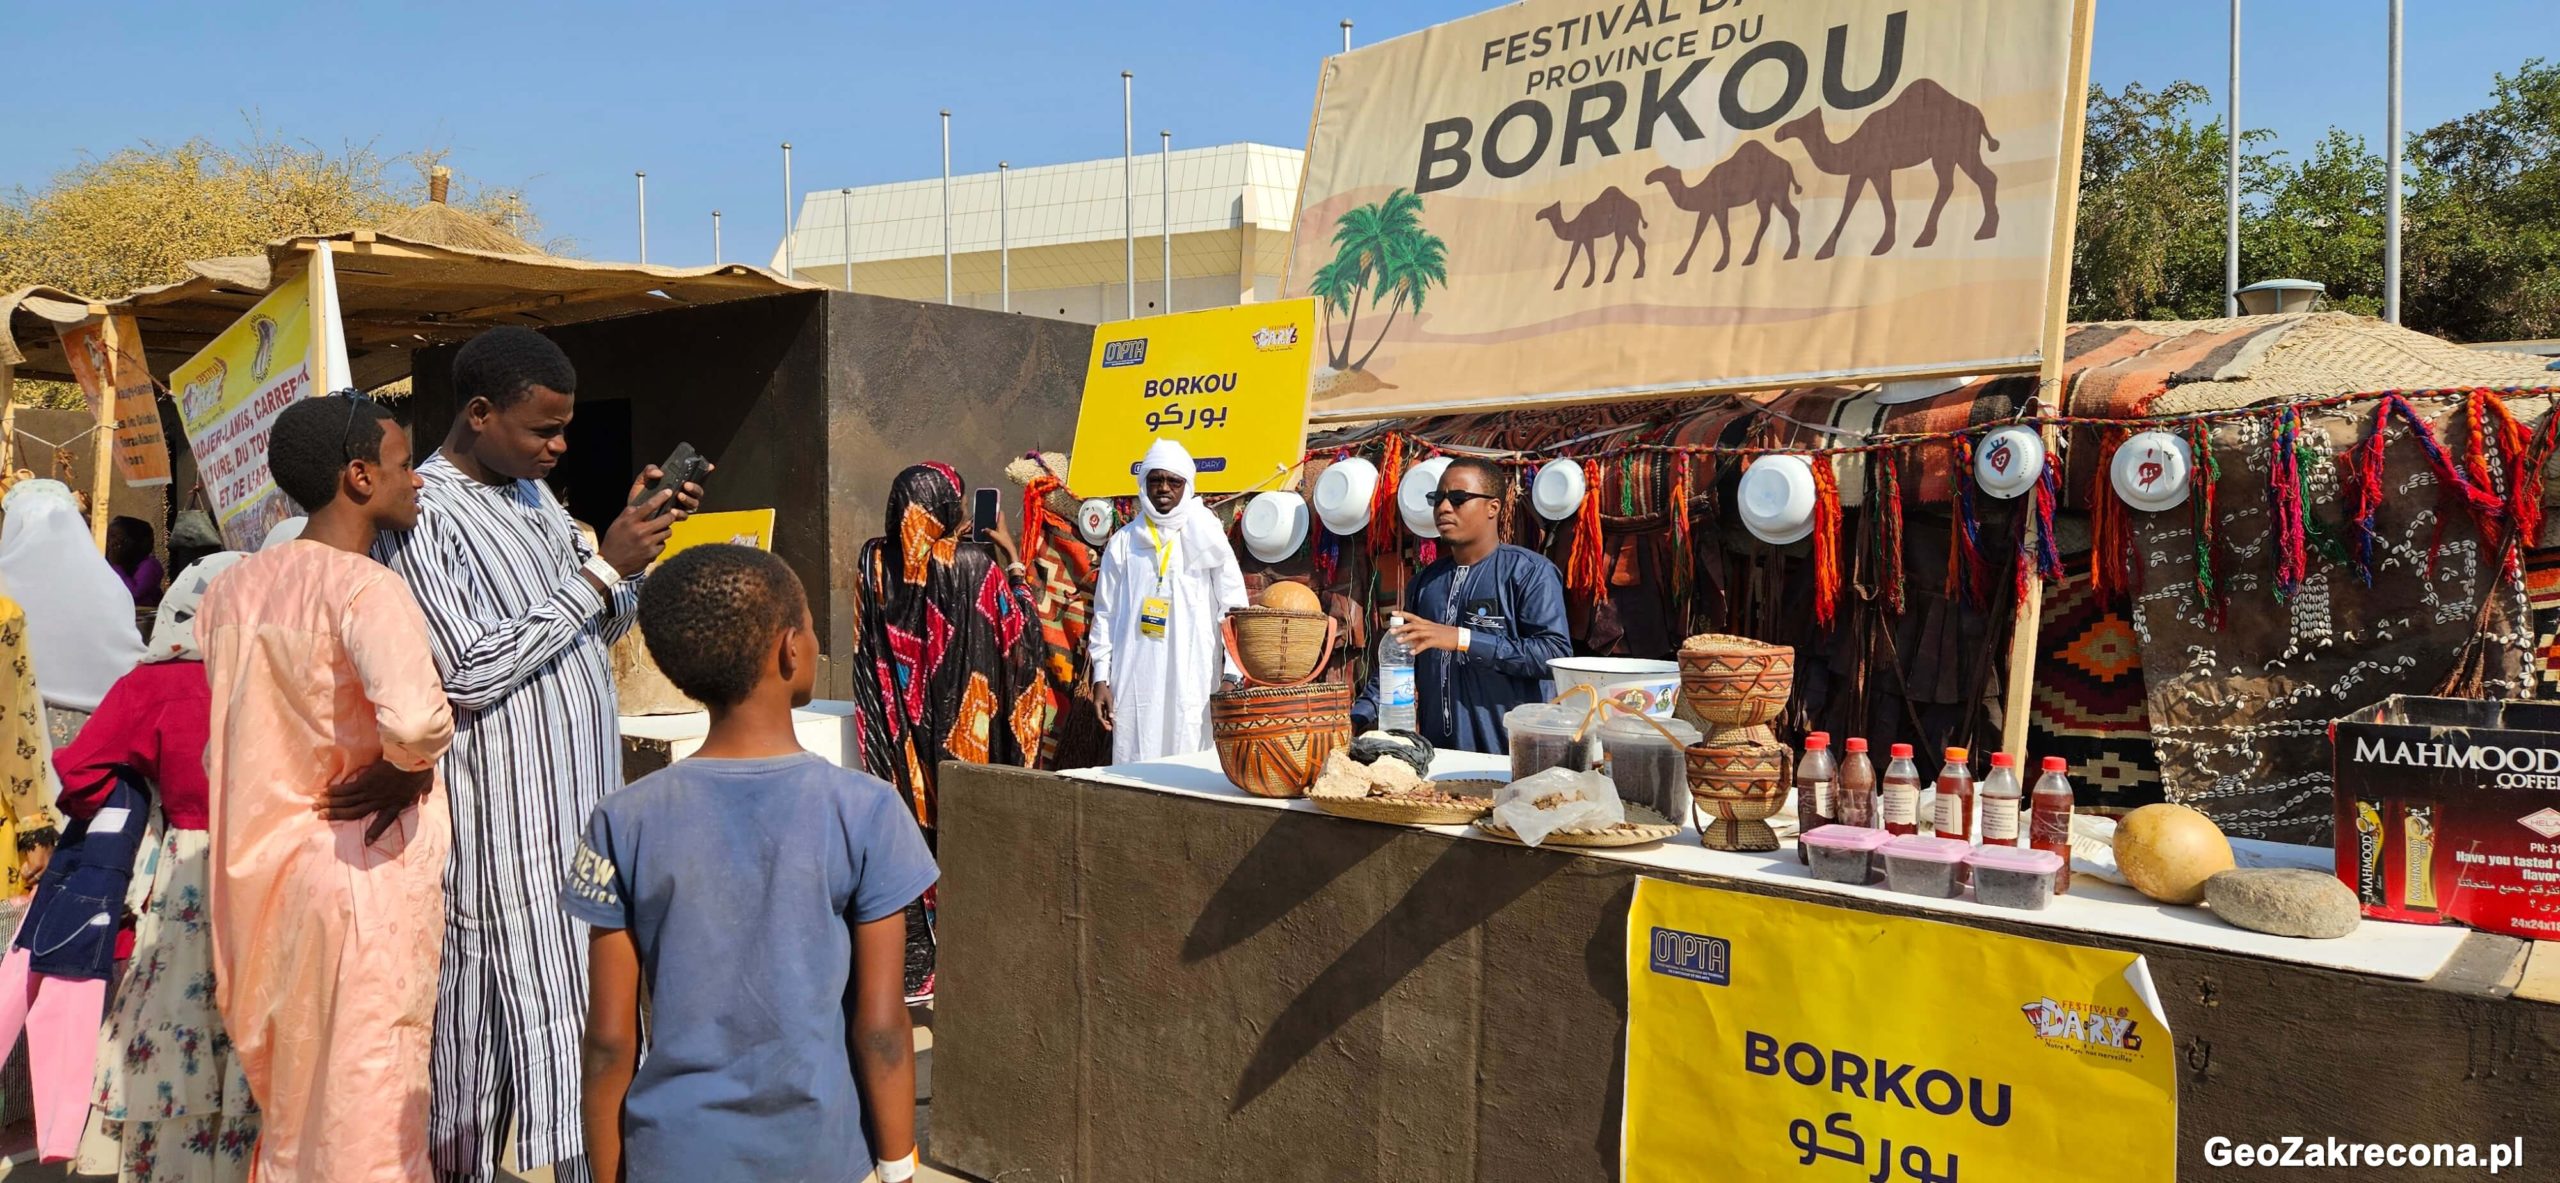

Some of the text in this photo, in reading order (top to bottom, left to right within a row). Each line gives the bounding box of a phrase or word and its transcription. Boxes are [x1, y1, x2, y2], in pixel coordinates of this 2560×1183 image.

[1481, 0, 1681, 72] FESTIVAL
[1526, 14, 1764, 95] PROVINCE DU
[1414, 10, 1907, 195] BORKOU
[1144, 373, 1238, 398] BORKOU
[1145, 403, 1228, 432] بوركو
[235, 441, 249, 468] DU
[219, 486, 230, 510] ET
[232, 477, 245, 501] DE
[2353, 736, 2560, 774] MAHMOOD
[2456, 851, 2486, 864] Have
[2488, 855, 2511, 867] you
[2513, 856, 2553, 869] tasted
[2530, 843, 2548, 853] PN:
[2361, 835, 2373, 896] MAHMOOD
[2411, 839, 2421, 900] MAHMOOD
[2062, 1000, 2113, 1015] FESTIVAL
[2045, 1041, 2064, 1050] Notre
[2098, 1051, 2133, 1063] merveilles
[1745, 1030, 2012, 1127] BORKOU
